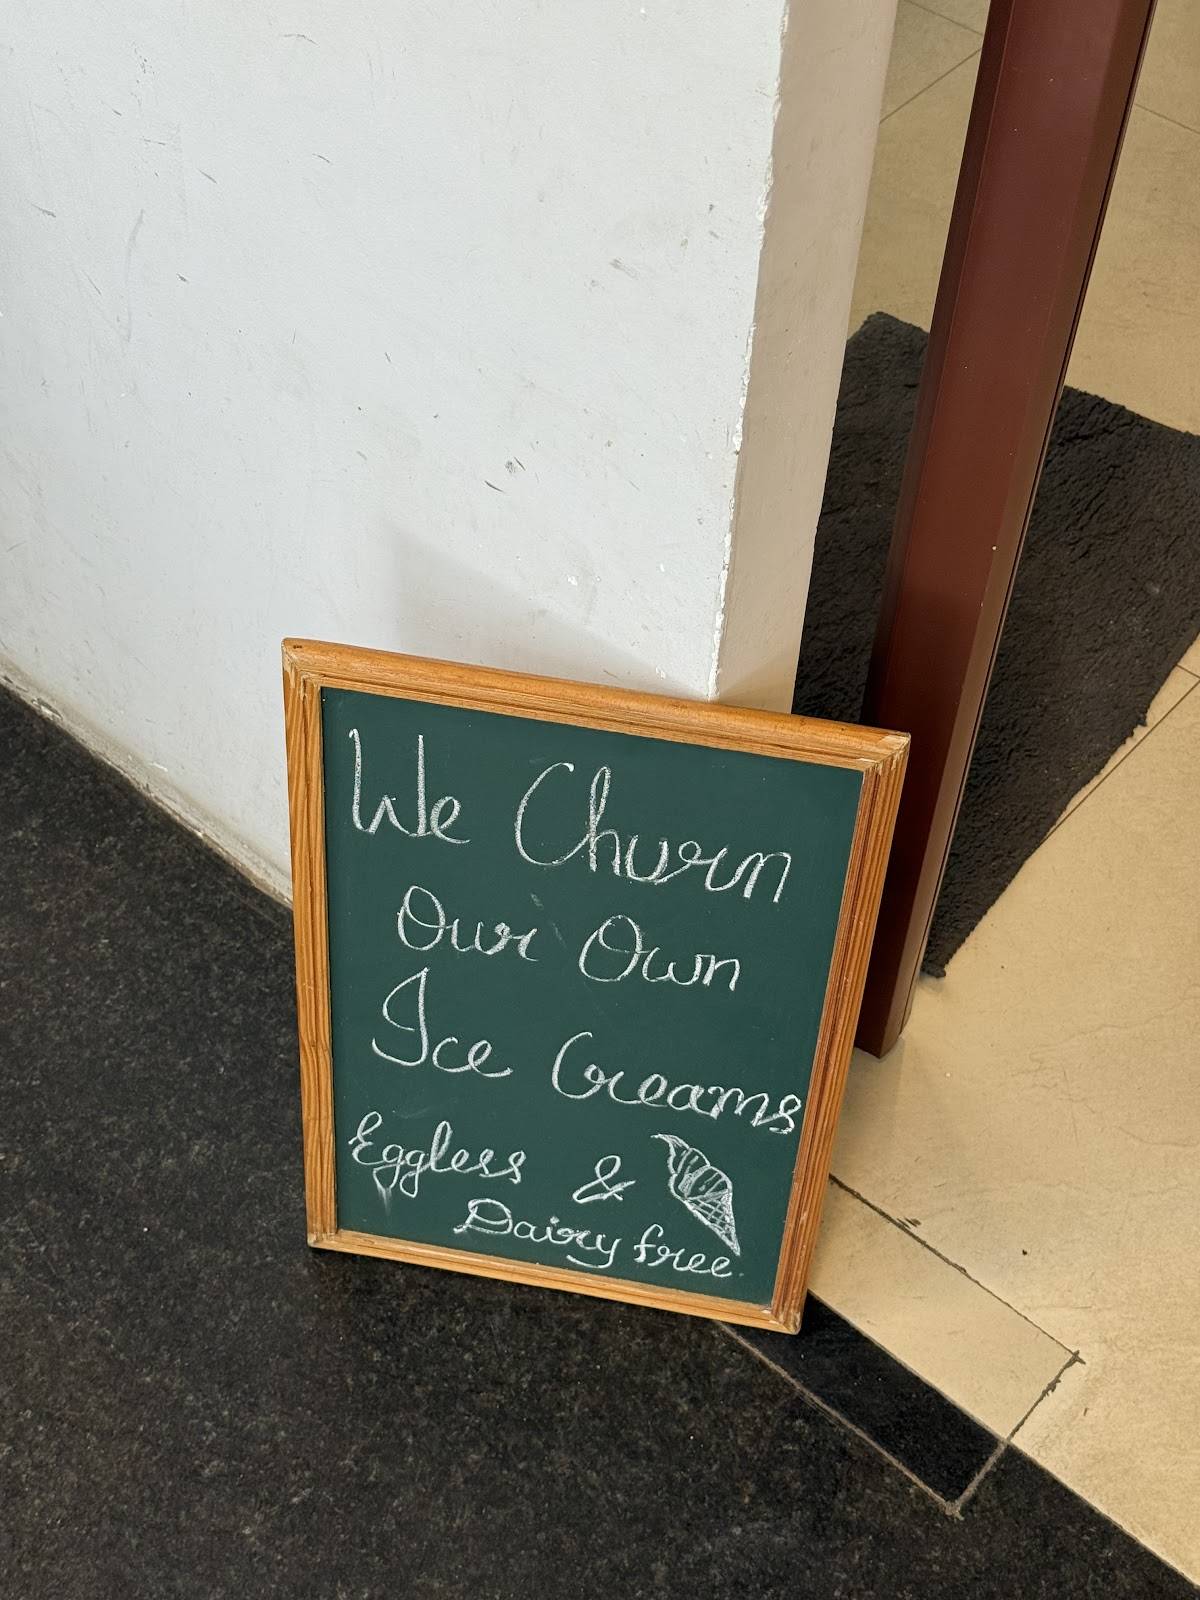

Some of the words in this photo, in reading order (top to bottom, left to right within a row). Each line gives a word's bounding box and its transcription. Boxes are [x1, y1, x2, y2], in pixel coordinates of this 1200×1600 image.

[348, 728, 471, 844] We
[513, 762, 792, 903] Churn
[396, 885, 538, 962] Our
[578, 914, 741, 992] Own
[371, 967, 514, 1077] Ice
[551, 1031, 802, 1135] Creams
[347, 1110, 527, 1199] Eggless
[571, 1154, 636, 1205] &
[452, 1197, 622, 1269] Dairy
